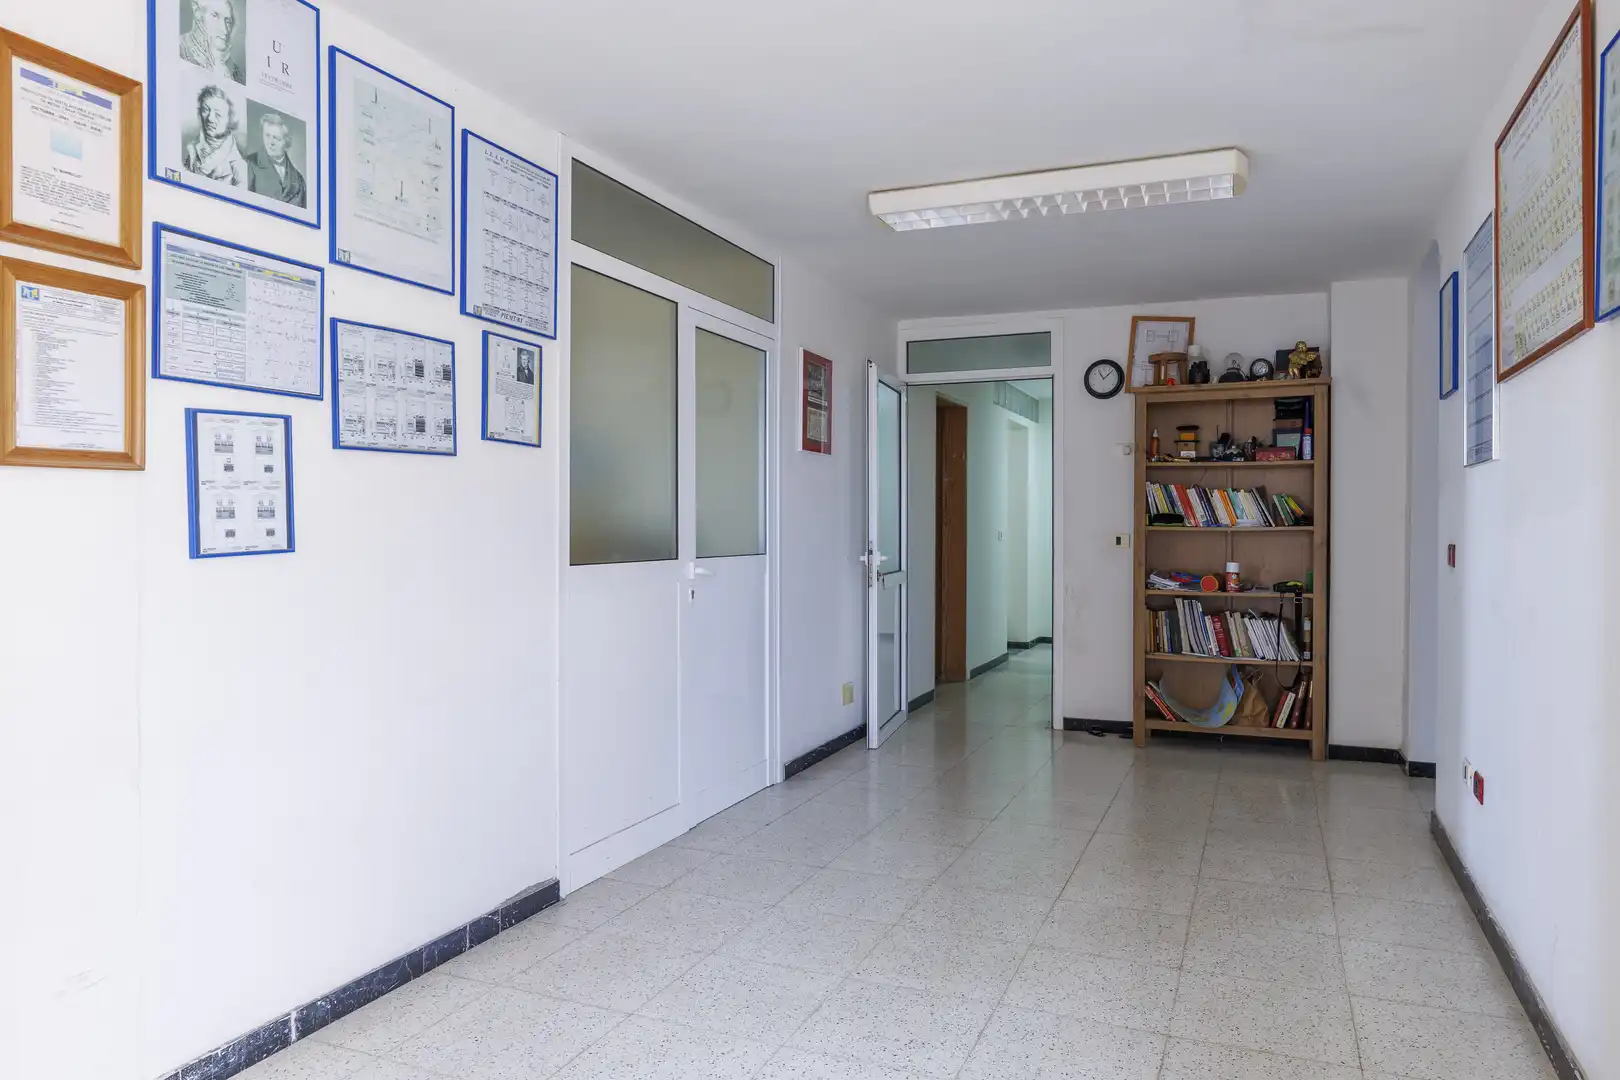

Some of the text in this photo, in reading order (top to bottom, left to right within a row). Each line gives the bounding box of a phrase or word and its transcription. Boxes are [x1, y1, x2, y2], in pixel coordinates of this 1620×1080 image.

[272, 40, 282, 54] U
[267, 56, 290, 76] I R
